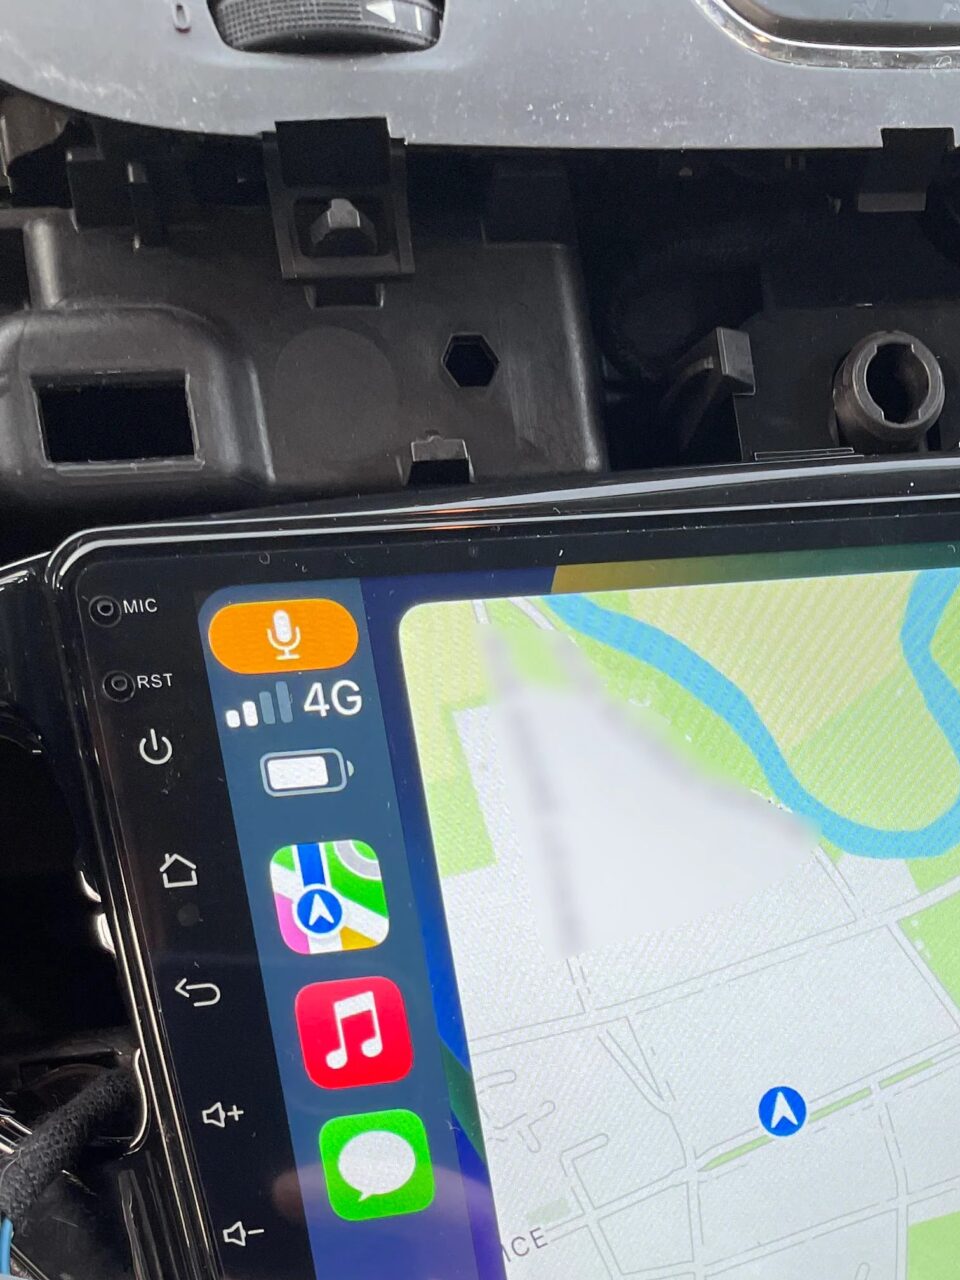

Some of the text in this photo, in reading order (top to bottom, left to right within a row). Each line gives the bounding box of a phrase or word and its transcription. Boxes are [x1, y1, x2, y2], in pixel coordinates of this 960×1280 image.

[123, 598, 158, 614] MIC
[136, 672, 173, 689] RST
[303, 679, 362, 717] 4G
